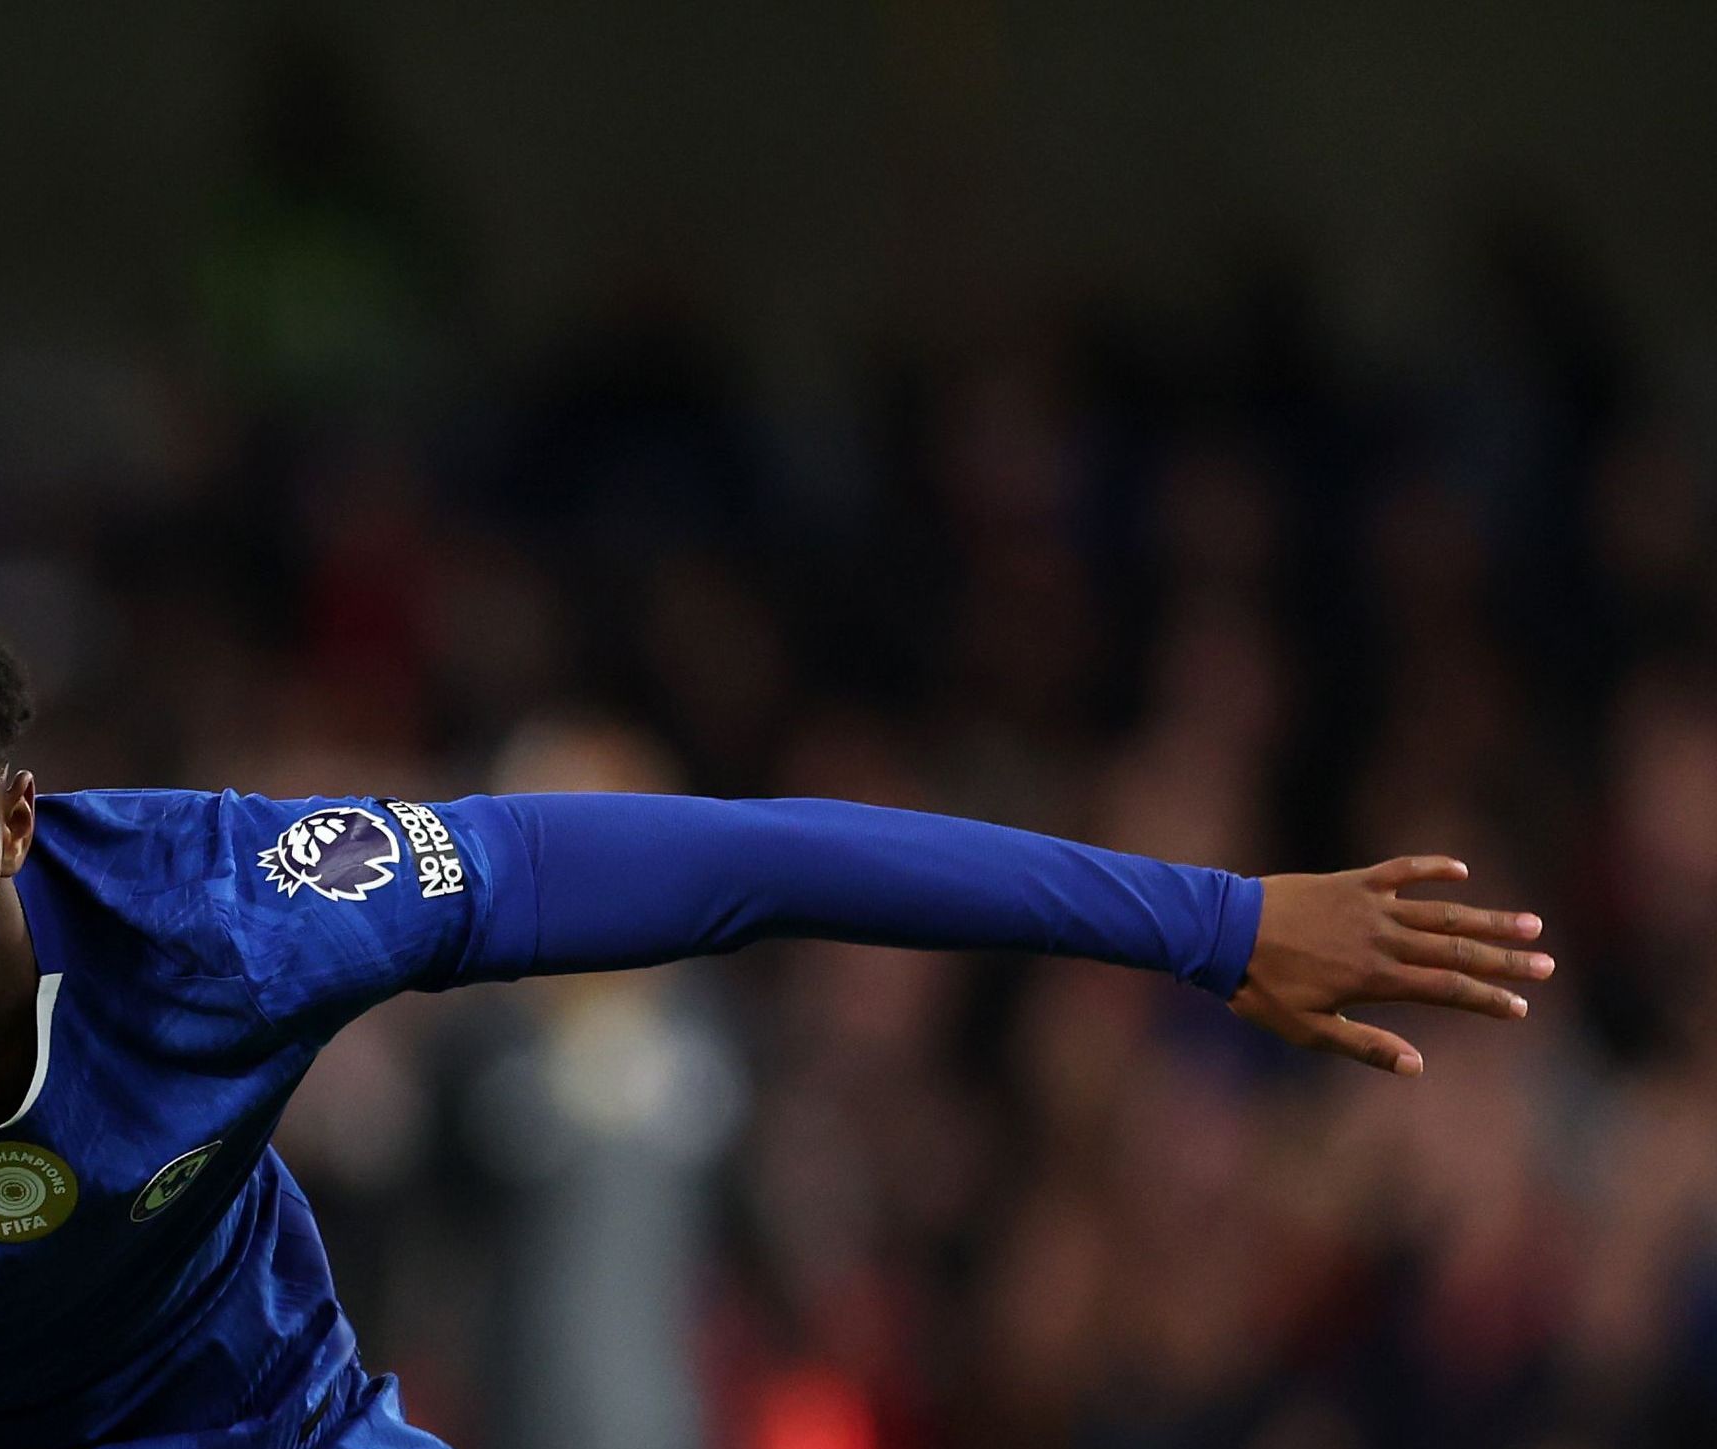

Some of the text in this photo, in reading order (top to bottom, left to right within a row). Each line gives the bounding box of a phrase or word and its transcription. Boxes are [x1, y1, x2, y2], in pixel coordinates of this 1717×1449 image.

[386, 801, 445, 898] No room
[0, 1215, 47, 1236] FIFA
